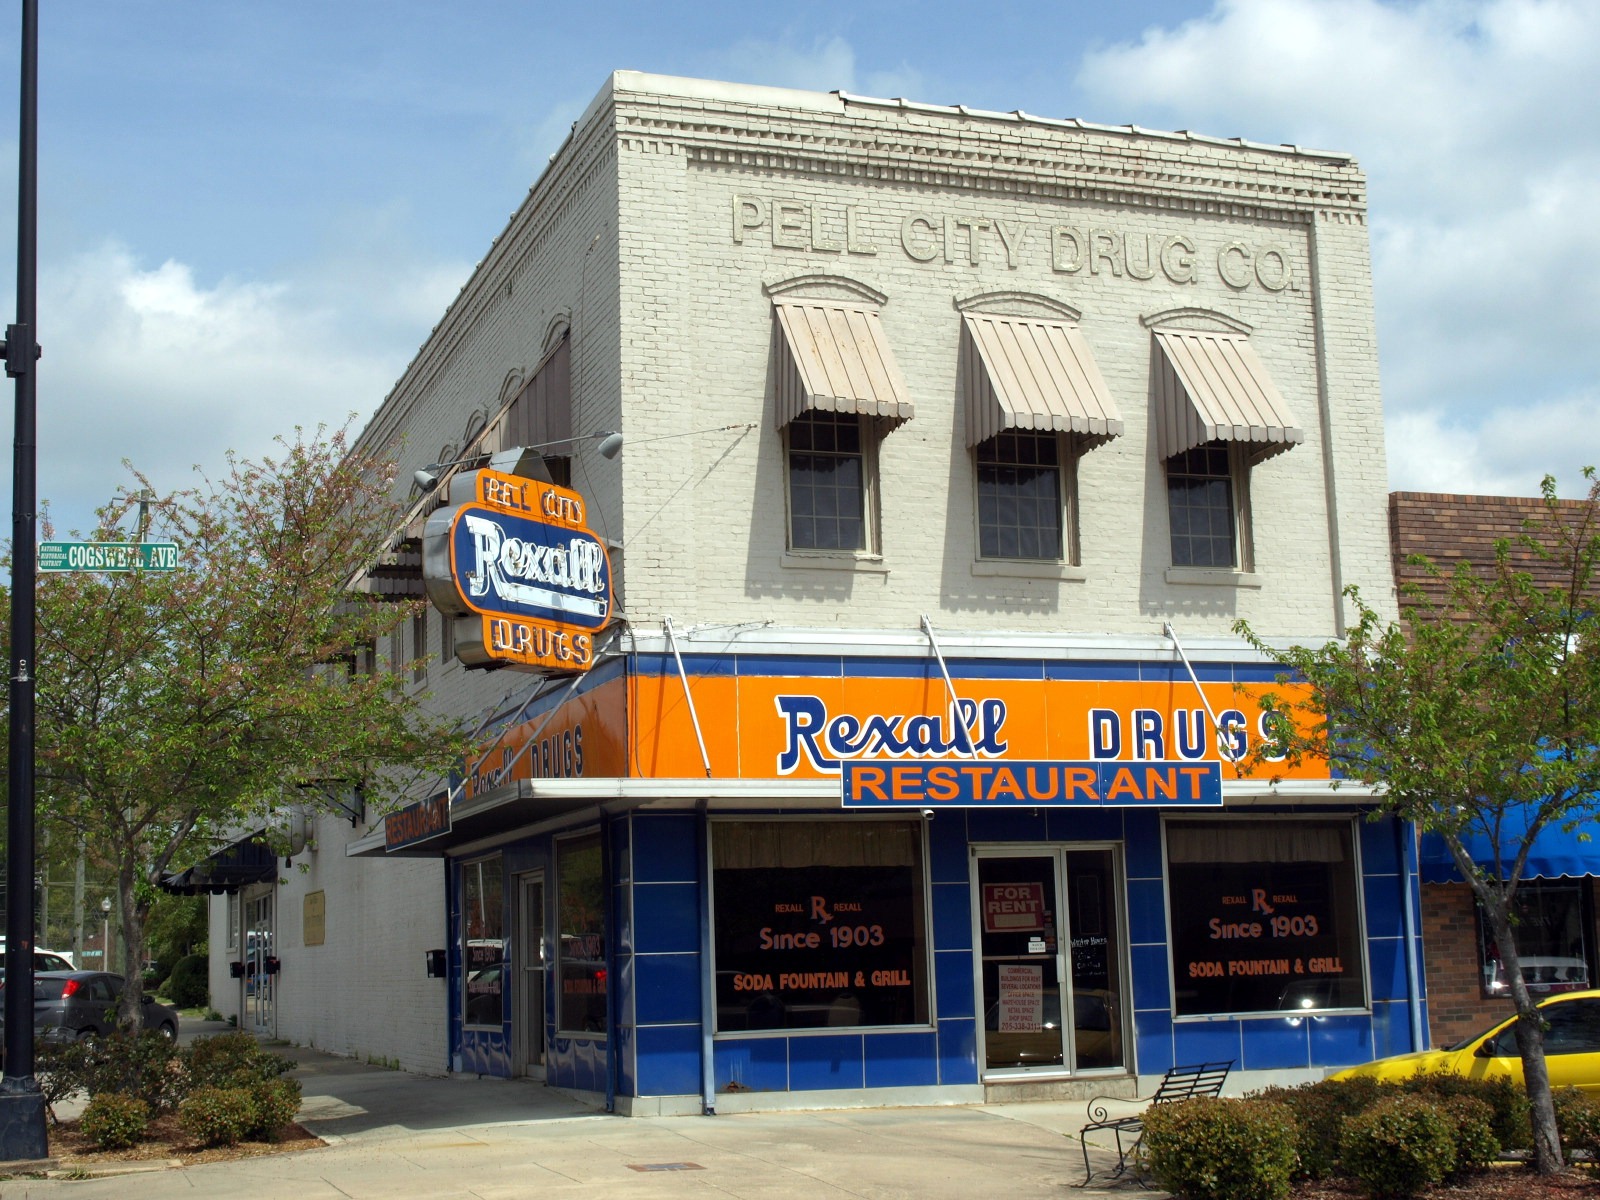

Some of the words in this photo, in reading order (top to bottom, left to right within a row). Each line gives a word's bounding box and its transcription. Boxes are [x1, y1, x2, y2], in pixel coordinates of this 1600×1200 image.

[732, 194, 877, 256] PELL
[901, 210, 1028, 269] CITY
[1050, 225, 1198, 284] DRUG
[150, 547, 175, 568] AVE
[464, 514, 608, 618] Rexall
[490, 619, 591, 664] DRUGS
[774, 695, 1009, 775] Rexall
[1088, 708, 1289, 762] DRUGS
[531, 724, 583, 778] DRUGS
[851, 767, 1210, 800] RESTAURANT
[386, 796, 449, 845] RESTAURANT
[994, 887, 1031, 899] FOR
[1222, 895, 1247, 905] REXALL
[1272, 894, 1297, 903] REXALL
[775, 903, 804, 913] REXALL
[833, 902, 862, 911] REXALL
[988, 900, 1039, 913] RENT
[760, 927, 821, 949] Since
[830, 924, 885, 948] 1903
[1209, 917, 1262, 939] Since
[1270, 915, 1318, 938] 1903
[1189, 961, 1224, 977] SODA
[1228, 959, 1290, 976] FOUNTAIN
[1294, 958, 1304, 974] &
[1308, 957, 1344, 973] GRILL
[733, 974, 773, 990] SODA
[780, 971, 848, 989] FOUNTAIN
[854, 971, 865, 987] &
[871, 970, 911, 986] GRILL
